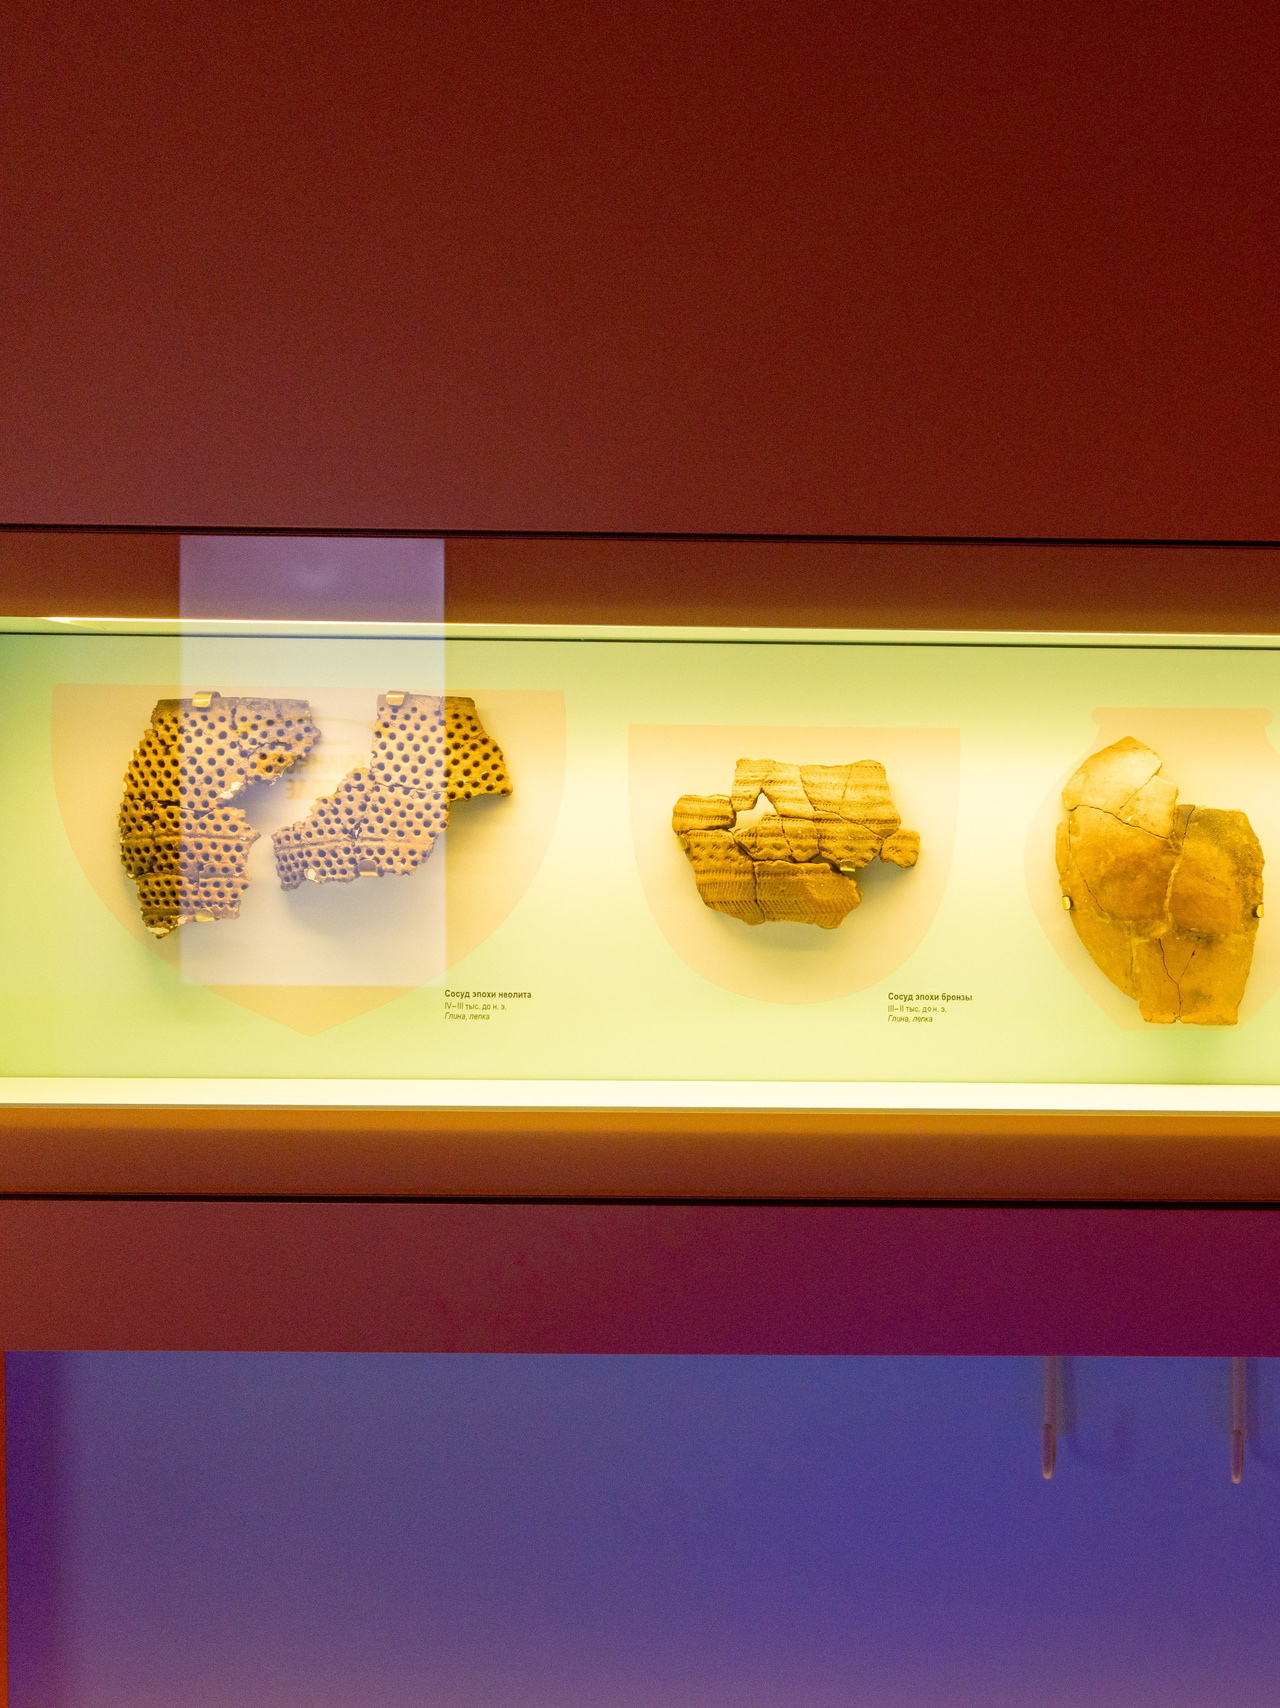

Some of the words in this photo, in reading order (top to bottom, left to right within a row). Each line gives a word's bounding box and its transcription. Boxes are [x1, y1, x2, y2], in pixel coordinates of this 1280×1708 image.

[444, 989, 470, 999] Сосуд
[888, 992, 913, 1002] Сосуд
[941, 993, 973, 1002] бронзы
[444, 1012, 468, 1021] Глина,
[888, 1015, 911, 1023] Глина,
